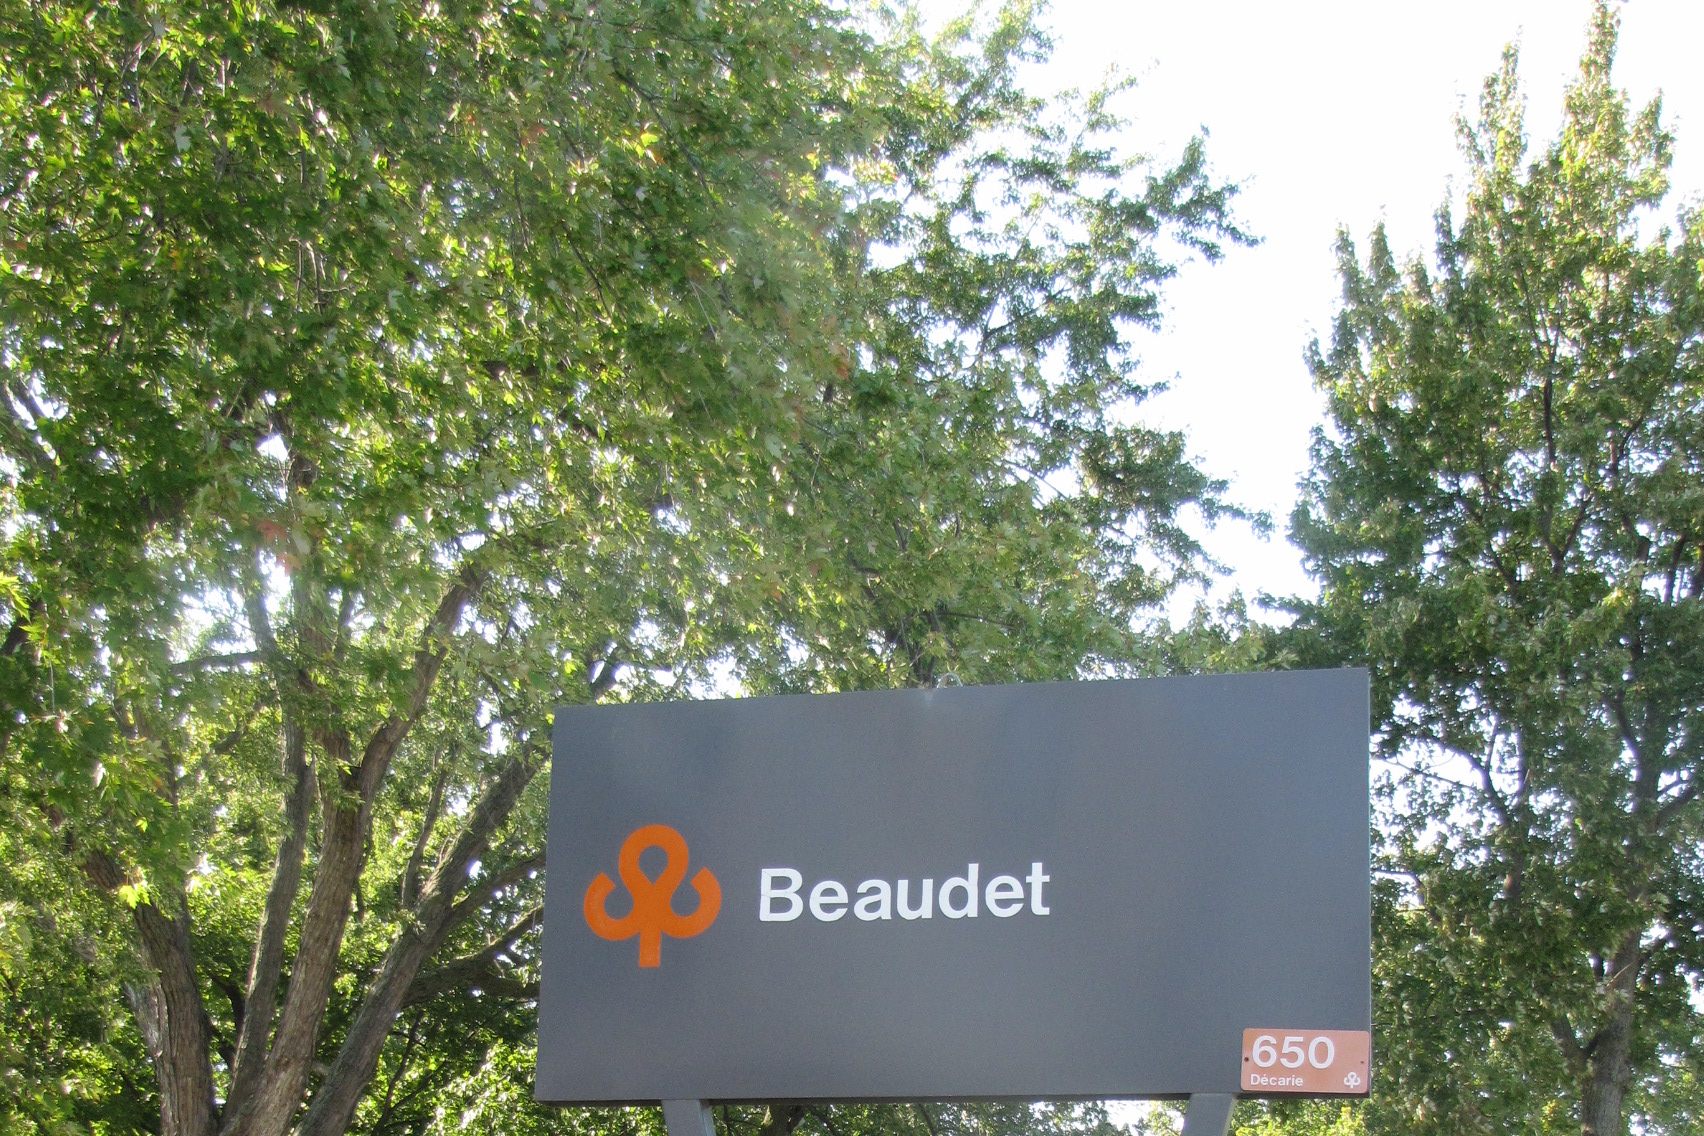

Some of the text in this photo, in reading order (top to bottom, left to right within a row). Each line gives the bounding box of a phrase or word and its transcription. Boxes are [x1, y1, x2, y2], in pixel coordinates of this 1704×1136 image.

[759, 861, 1051, 922] Beaudet
[1252, 1035, 1335, 1069] 650
[1250, 1073, 1304, 1087] Décarie
